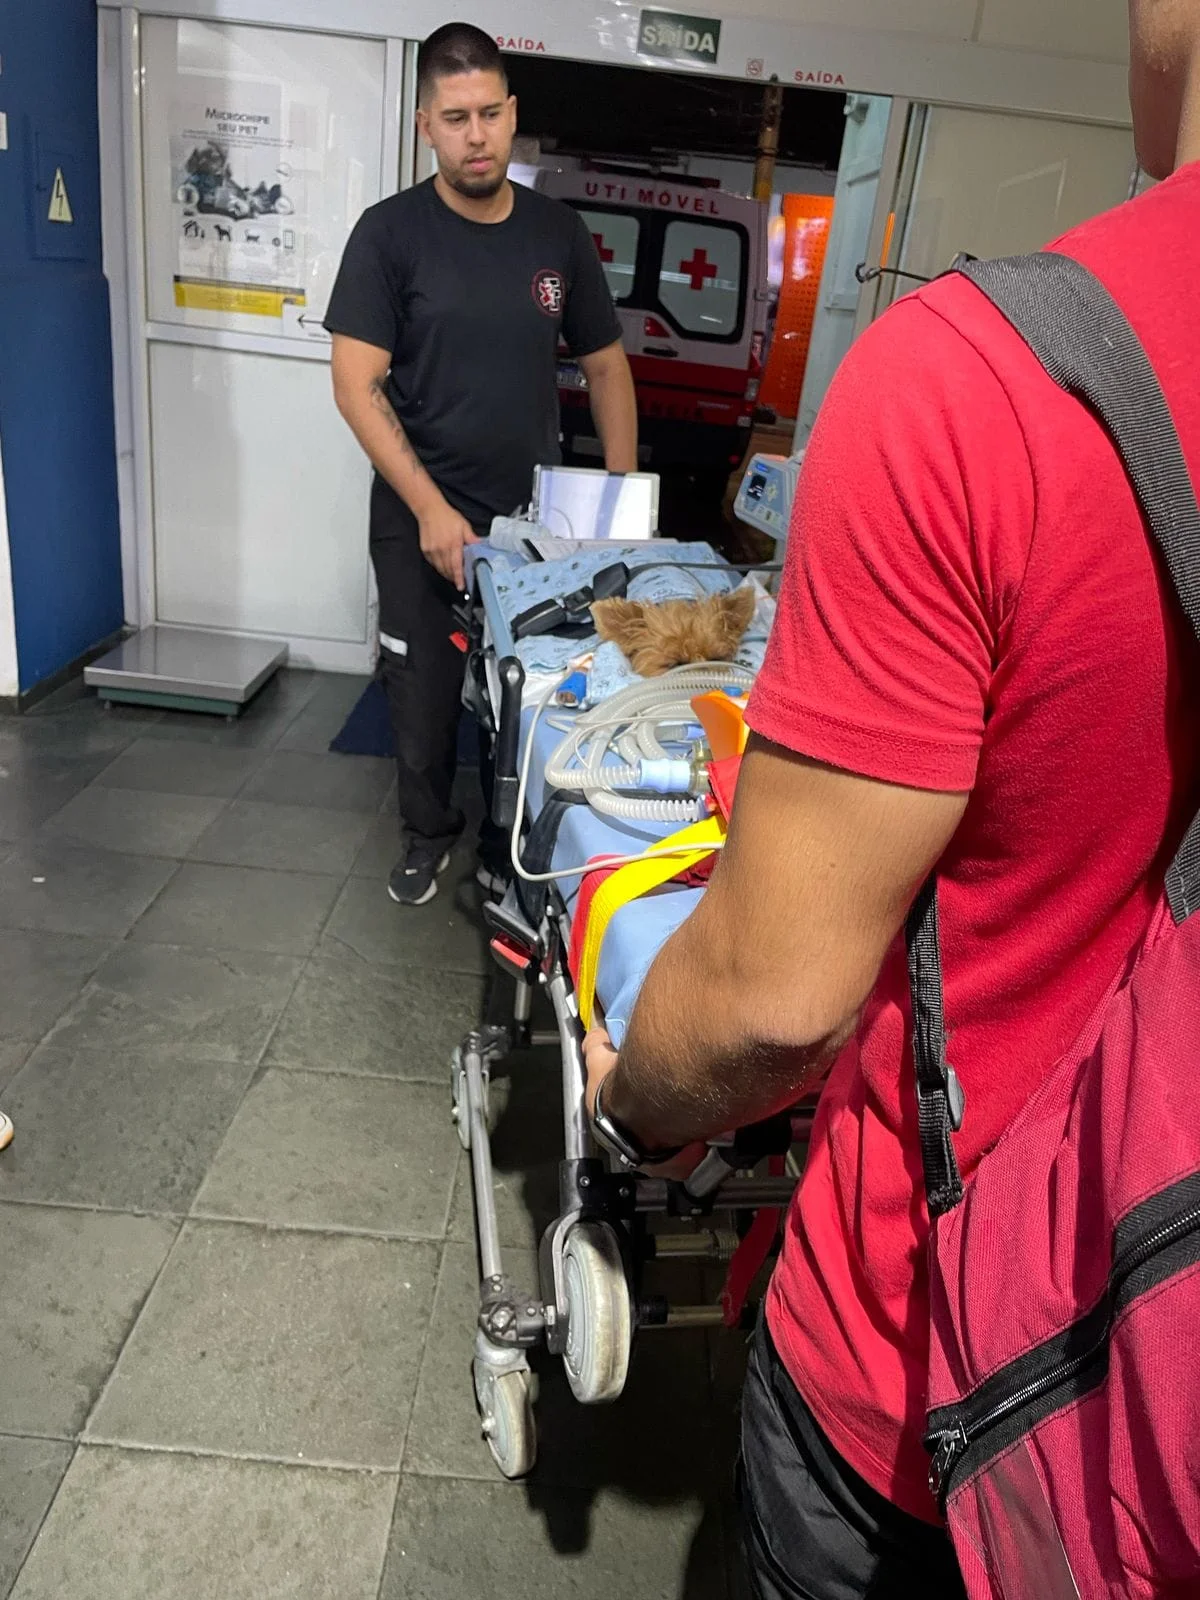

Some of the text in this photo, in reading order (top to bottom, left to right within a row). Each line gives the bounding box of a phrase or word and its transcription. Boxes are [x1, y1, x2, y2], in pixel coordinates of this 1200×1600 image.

[496, 36, 546, 52] SAÍDA
[641, 24, 716, 53] SAÍDA
[795, 71, 844, 85] SAÍDA
[239, 125, 258, 135] PET
[585, 181, 625, 201] UTI
